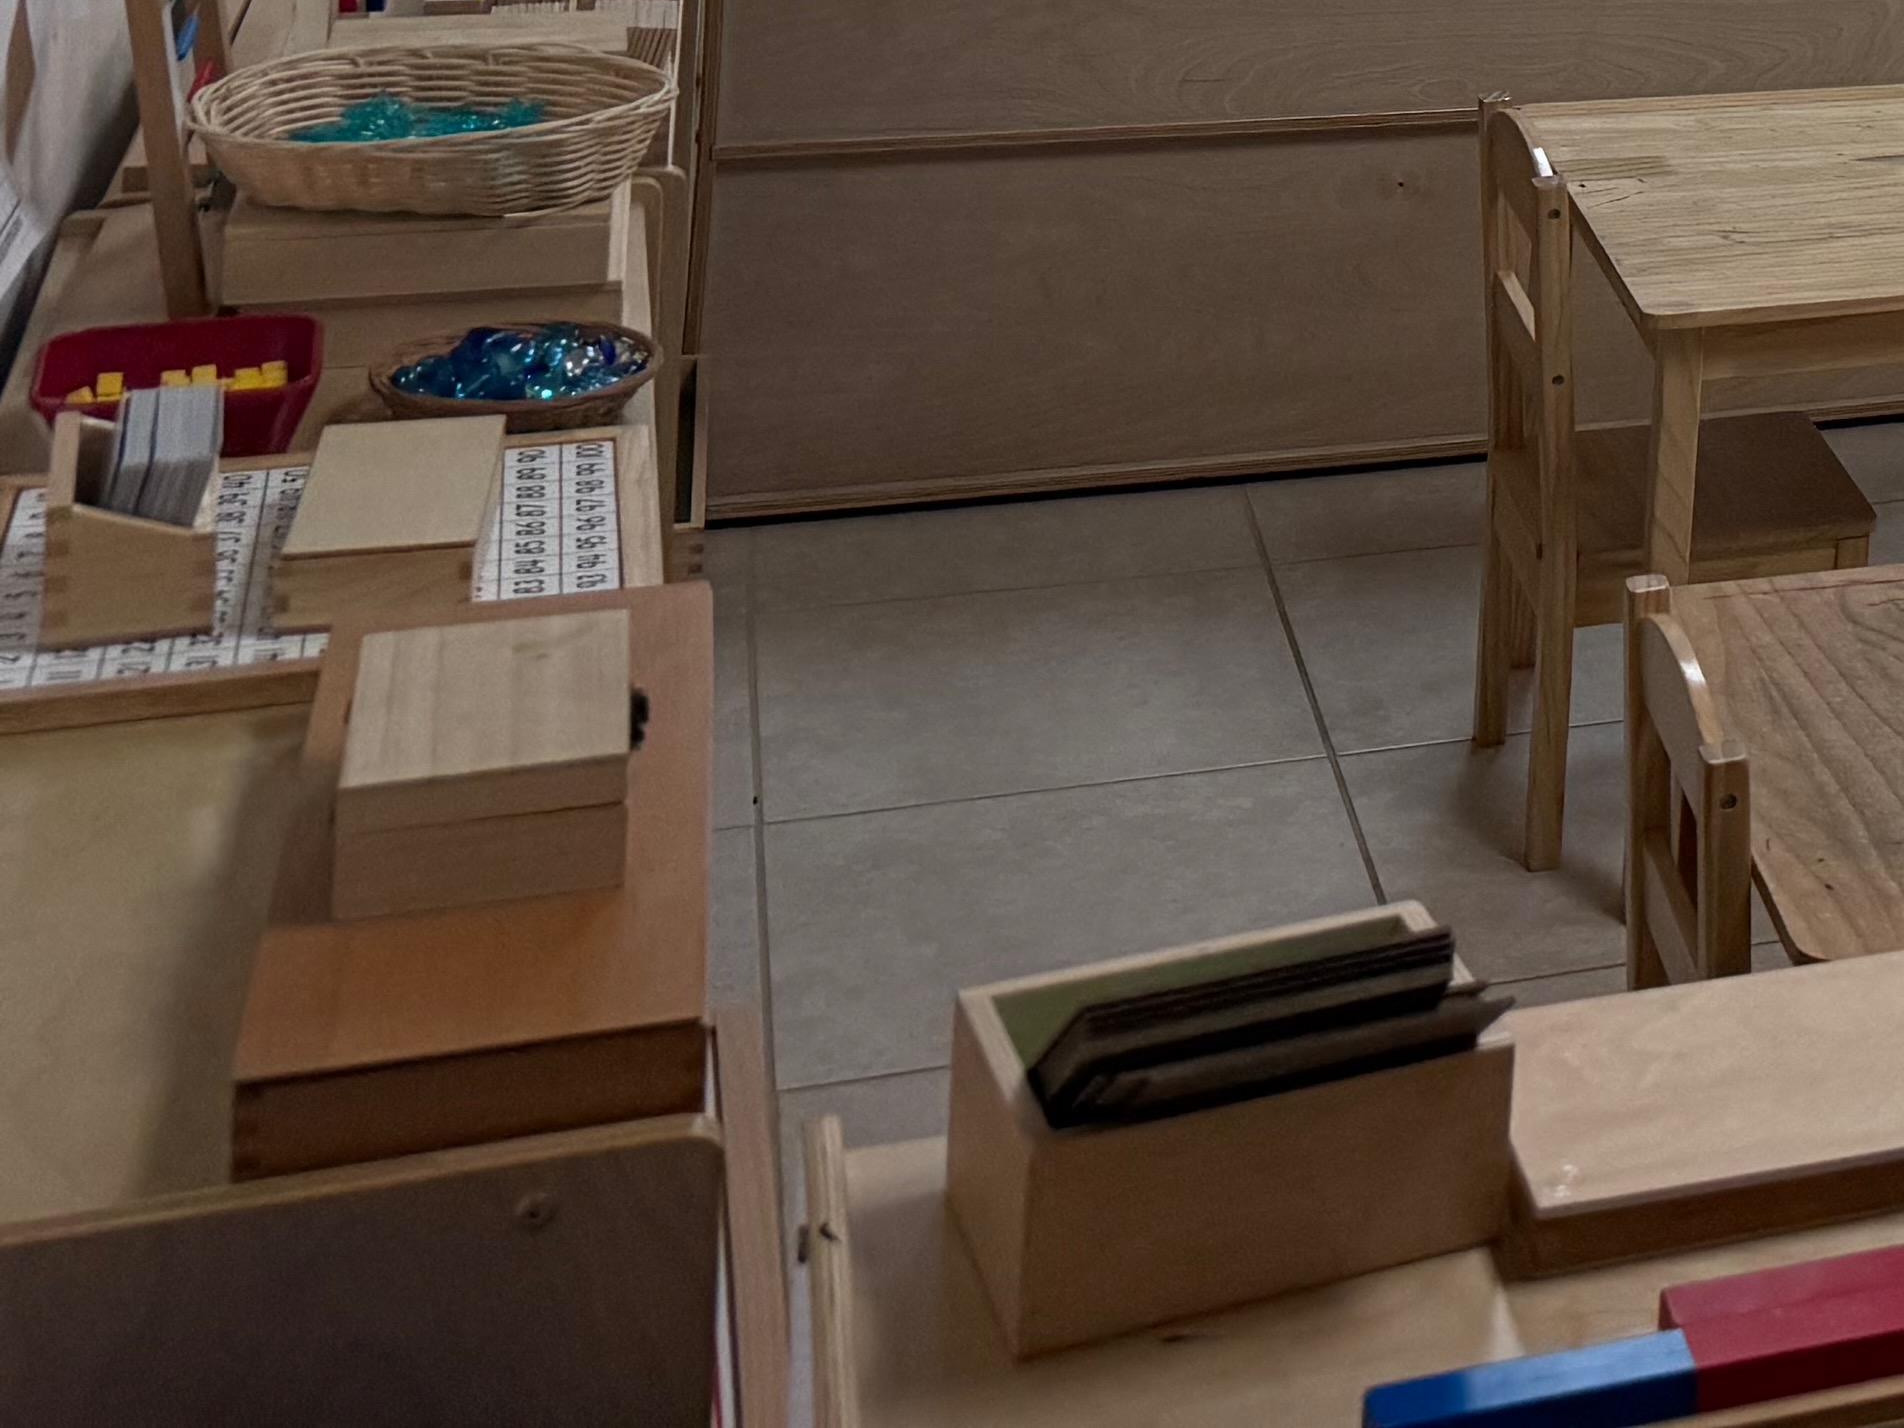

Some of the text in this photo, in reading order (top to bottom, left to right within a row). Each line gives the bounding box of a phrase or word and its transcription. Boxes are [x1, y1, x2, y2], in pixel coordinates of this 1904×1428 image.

[516, 449, 546, 464] 90
[515, 467, 546, 480] 89
[515, 484, 546, 499] 88
[575, 479, 605, 494] 98
[515, 504, 546, 517] 87
[575, 498, 606, 512] 97
[515, 520, 546, 536] 86
[575, 515, 607, 532] 96
[514, 540, 546, 555] 85
[575, 535, 607, 550] 95
[513, 559, 545, 575] 84
[576, 554, 607, 569] 94
[512, 579, 545, 594] 83
[576, 573, 607, 589] 93
